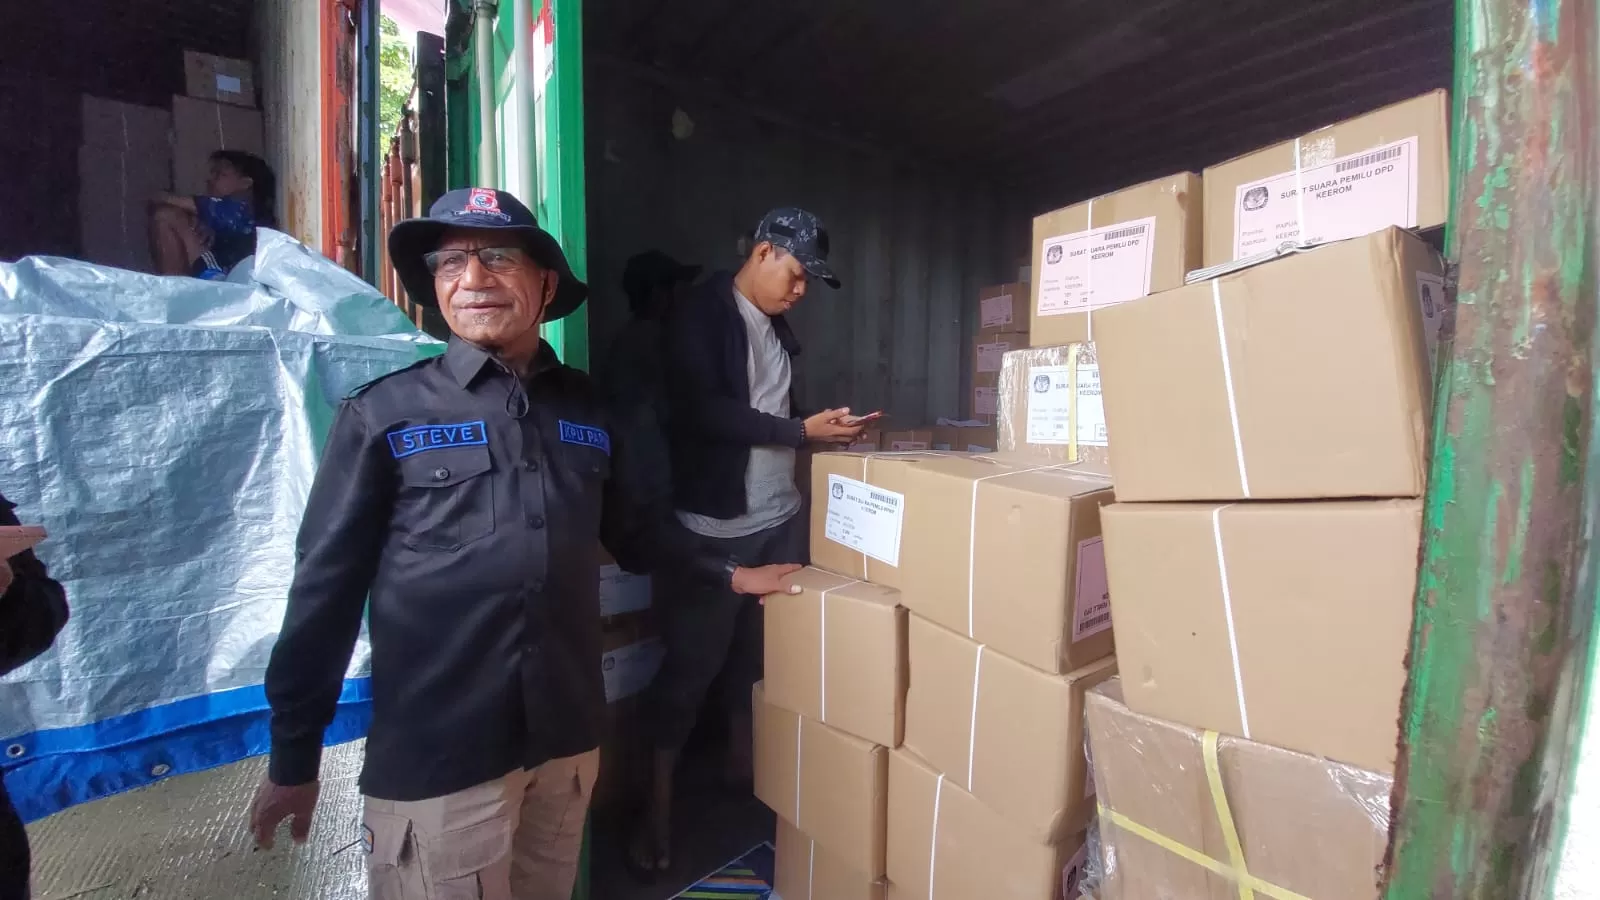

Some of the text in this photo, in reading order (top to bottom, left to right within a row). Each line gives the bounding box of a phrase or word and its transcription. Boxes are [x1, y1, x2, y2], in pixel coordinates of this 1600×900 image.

[1280, 164, 1394, 199] SURT SUARA PEMILU DPD
[1316, 185, 1352, 199] KEEROM
[403, 427, 474, 449] STEVE
[564, 424, 584, 441] KPU
